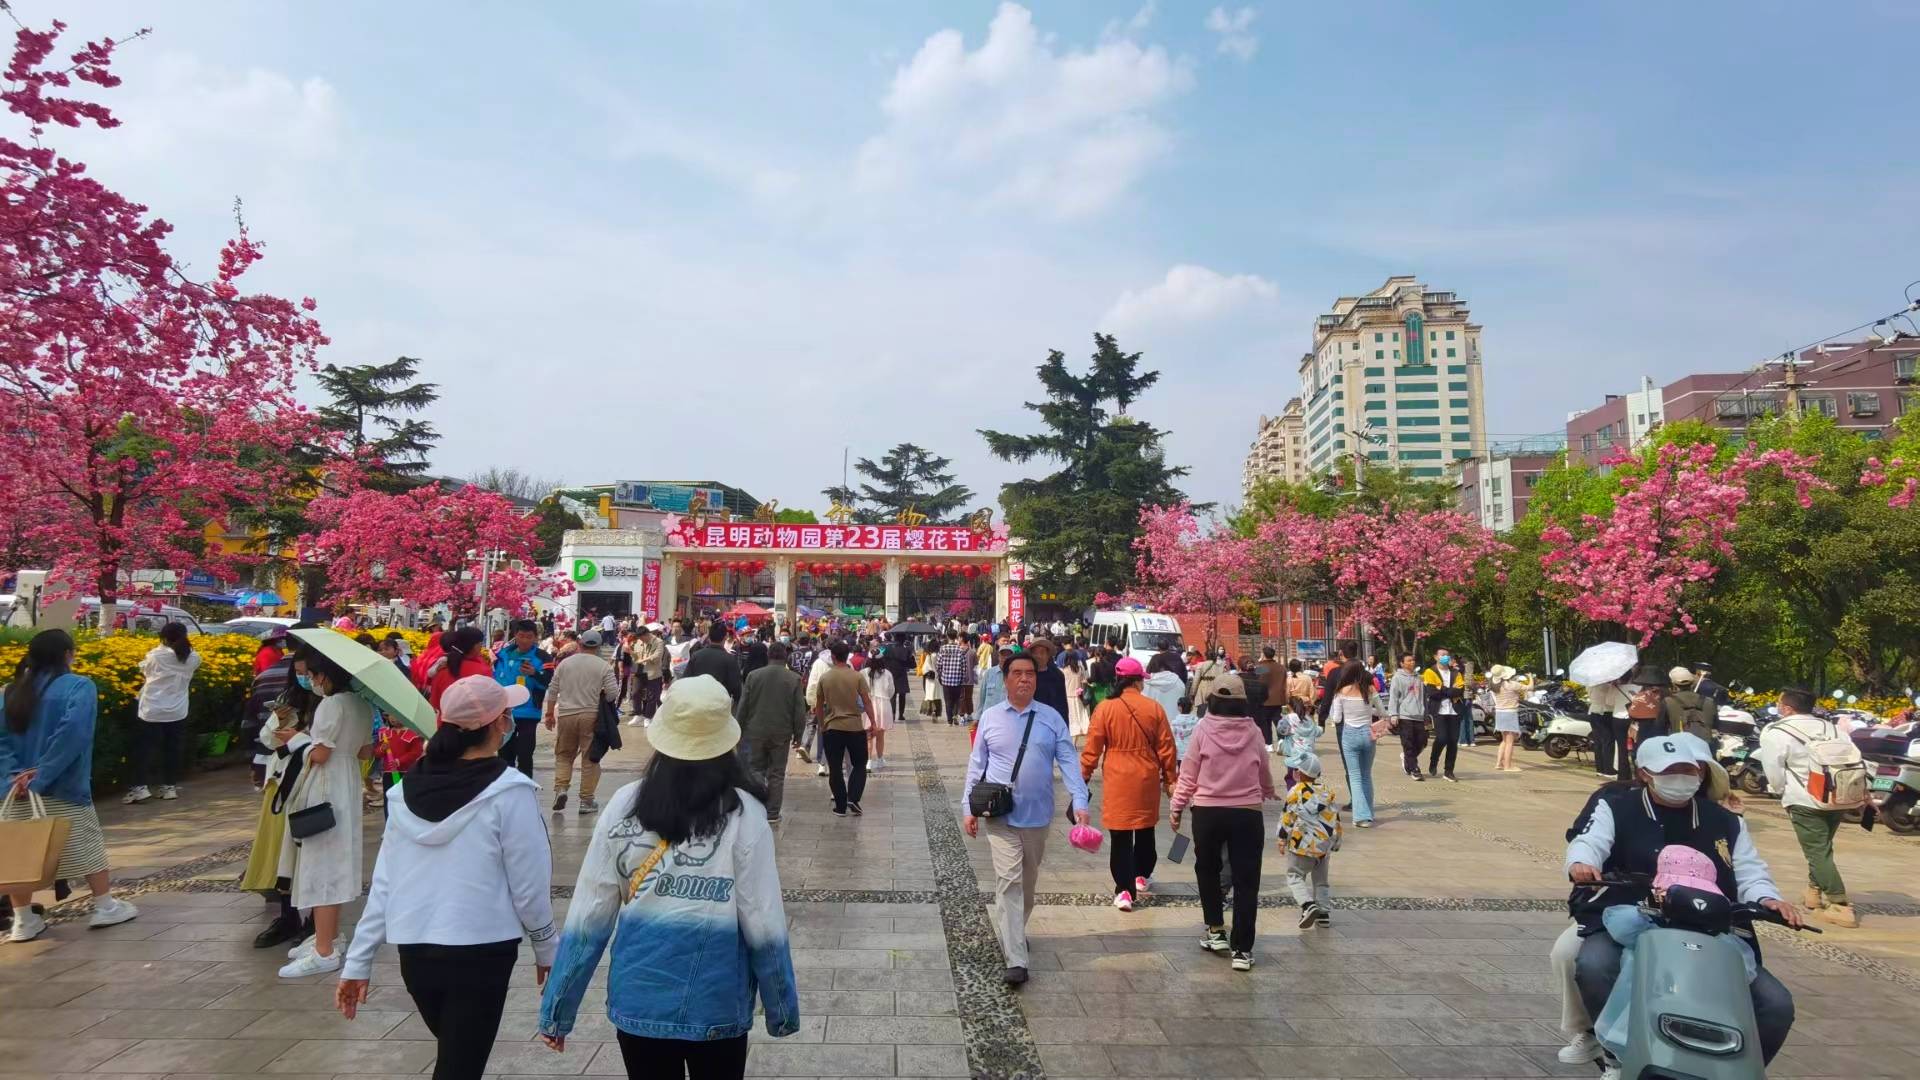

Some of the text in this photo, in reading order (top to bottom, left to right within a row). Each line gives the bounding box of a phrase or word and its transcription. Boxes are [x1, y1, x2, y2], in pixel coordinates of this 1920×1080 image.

[705, 526, 970, 550] 昆明动物园第23届樱花节
[1662, 742, 1676, 753] C
[655, 873, 735, 902] B.DUCK
